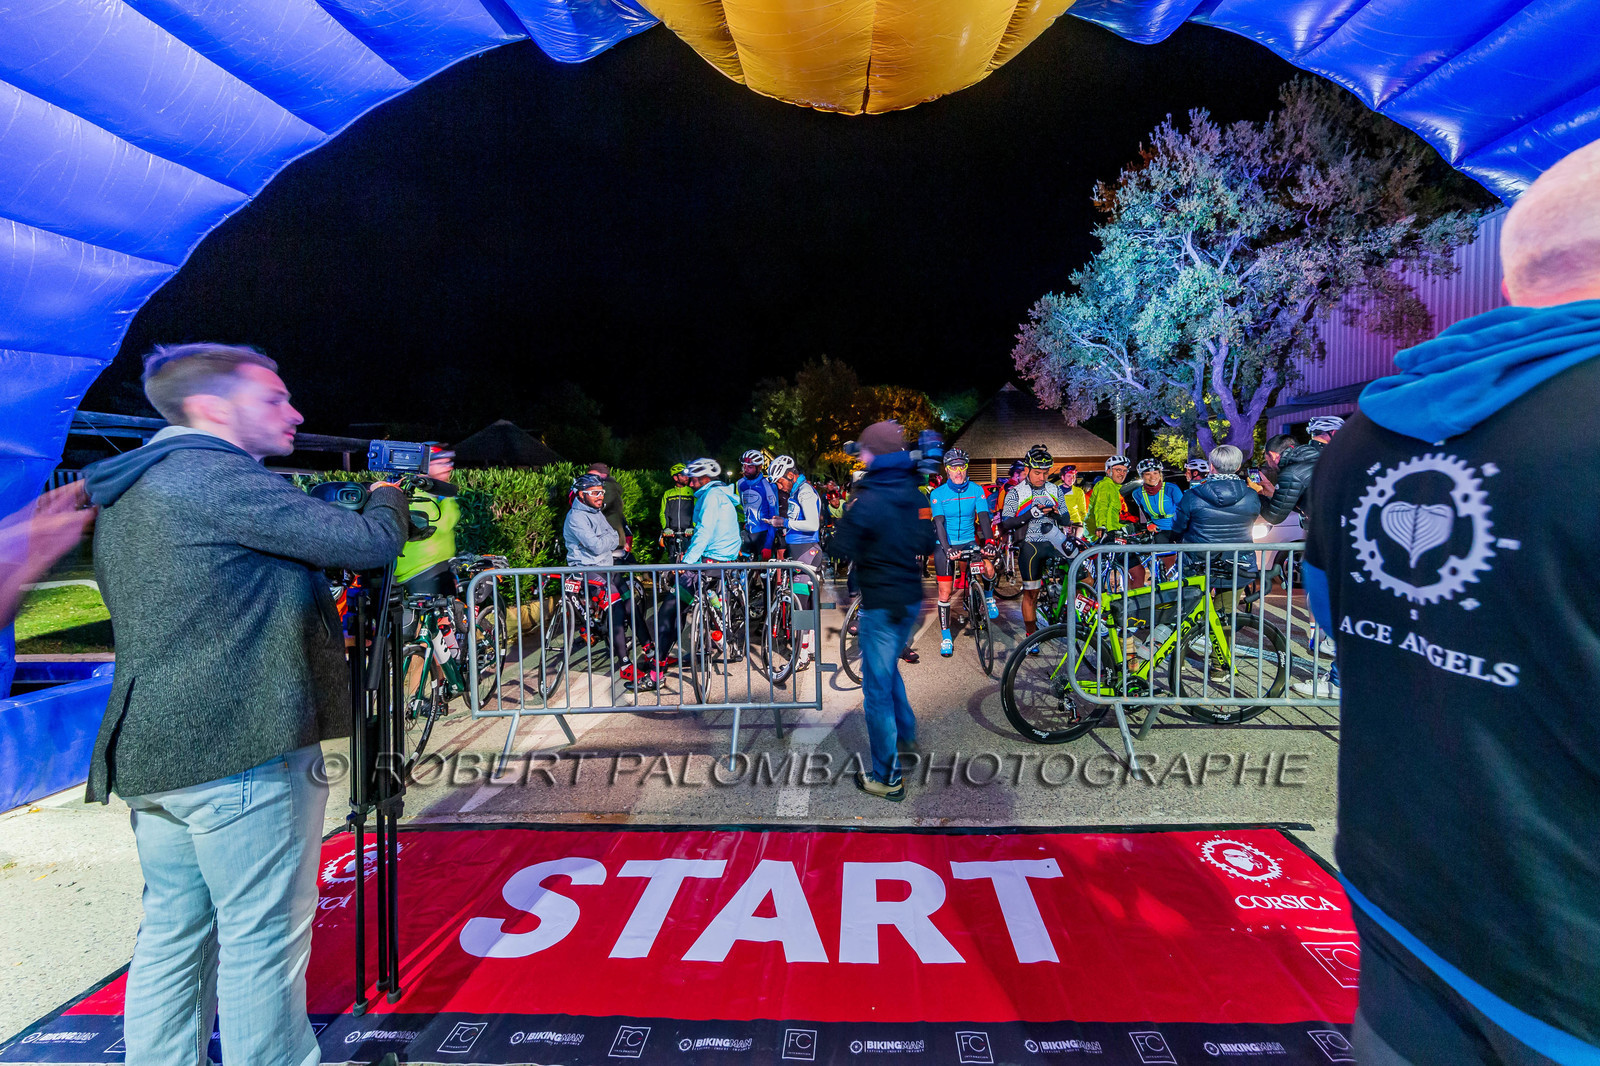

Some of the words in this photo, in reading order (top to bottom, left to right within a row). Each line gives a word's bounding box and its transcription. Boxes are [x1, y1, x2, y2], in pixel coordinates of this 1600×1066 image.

[1339, 615, 1392, 645] ACE
[1399, 632, 1520, 687] ANGELS
[1234, 895, 1341, 911] CORSICA
[459, 857, 1064, 963] START
[363, 1030, 420, 1040] BIKINGMAN
[527, 1031, 584, 1043] BIKINGMAN
[696, 1038, 752, 1048] BIKINGMAN
[867, 1040, 924, 1050] BIKINGMAN
[1041, 1039, 1101, 1051] BIKINGMAN
[1220, 1042, 1284, 1053] BIKINGMAN
